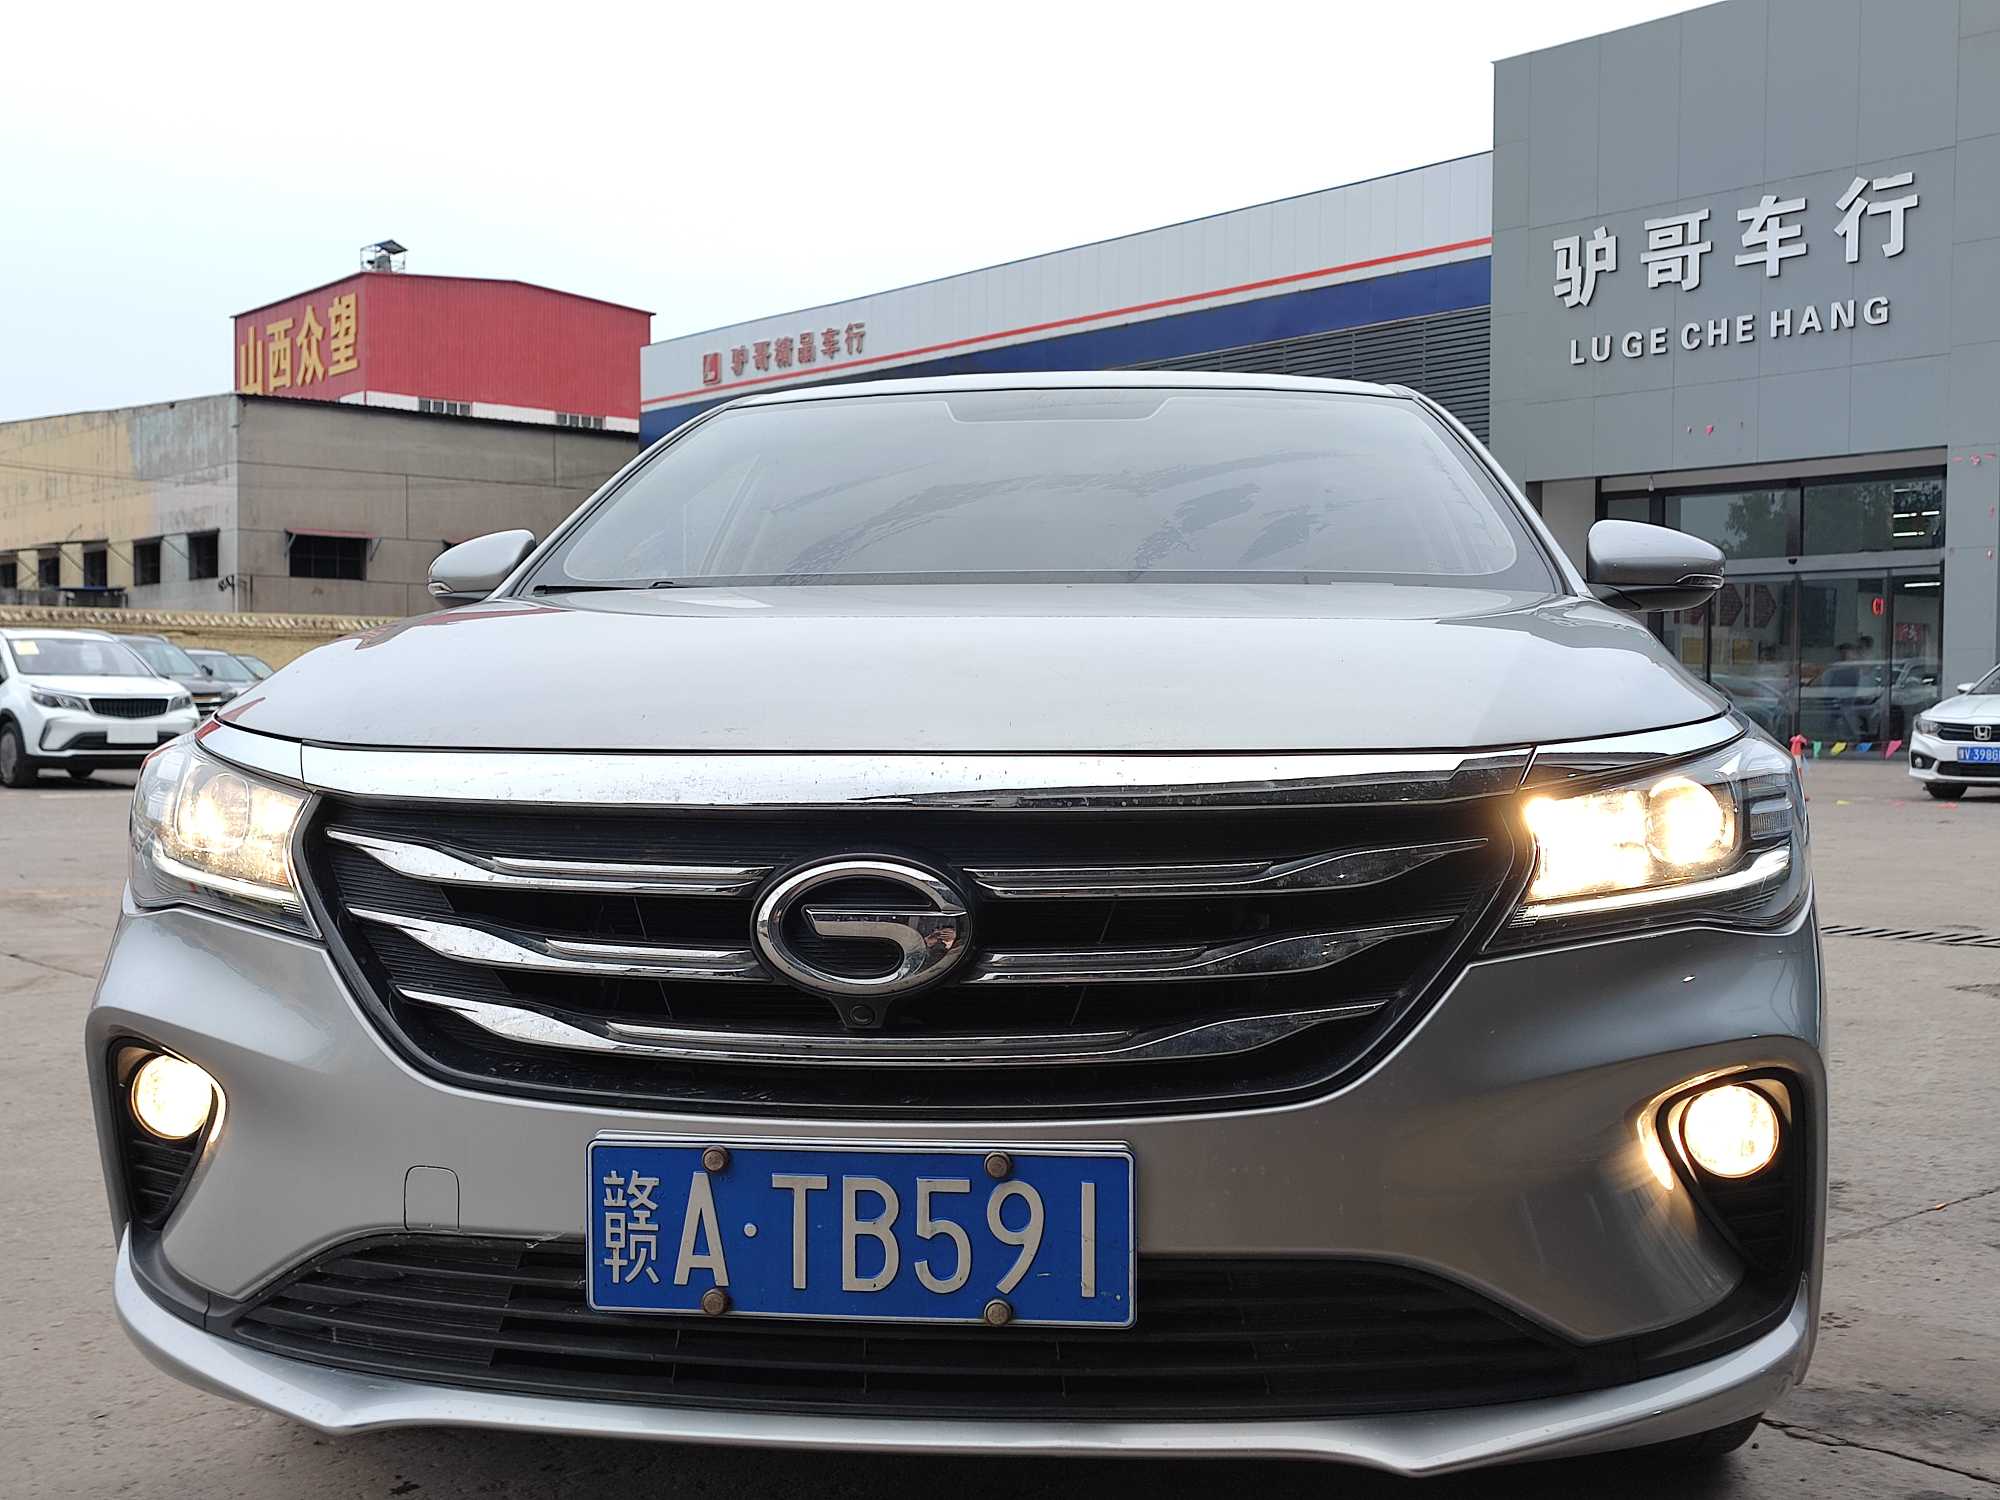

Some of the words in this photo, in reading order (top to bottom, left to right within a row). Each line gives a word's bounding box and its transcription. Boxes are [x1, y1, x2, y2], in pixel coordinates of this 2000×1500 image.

[1553, 171, 1919, 308] 驴哥车行
[240, 291, 358, 395] 山西众望
[730, 322, 866, 377] 驴哥精品车行
[1569, 327, 1668, 366] LUGE
[1681, 313, 1755, 350] CHE
[1769, 295, 1890, 339] HANG
[602, 1169, 1097, 1299] 赣A·TB591
